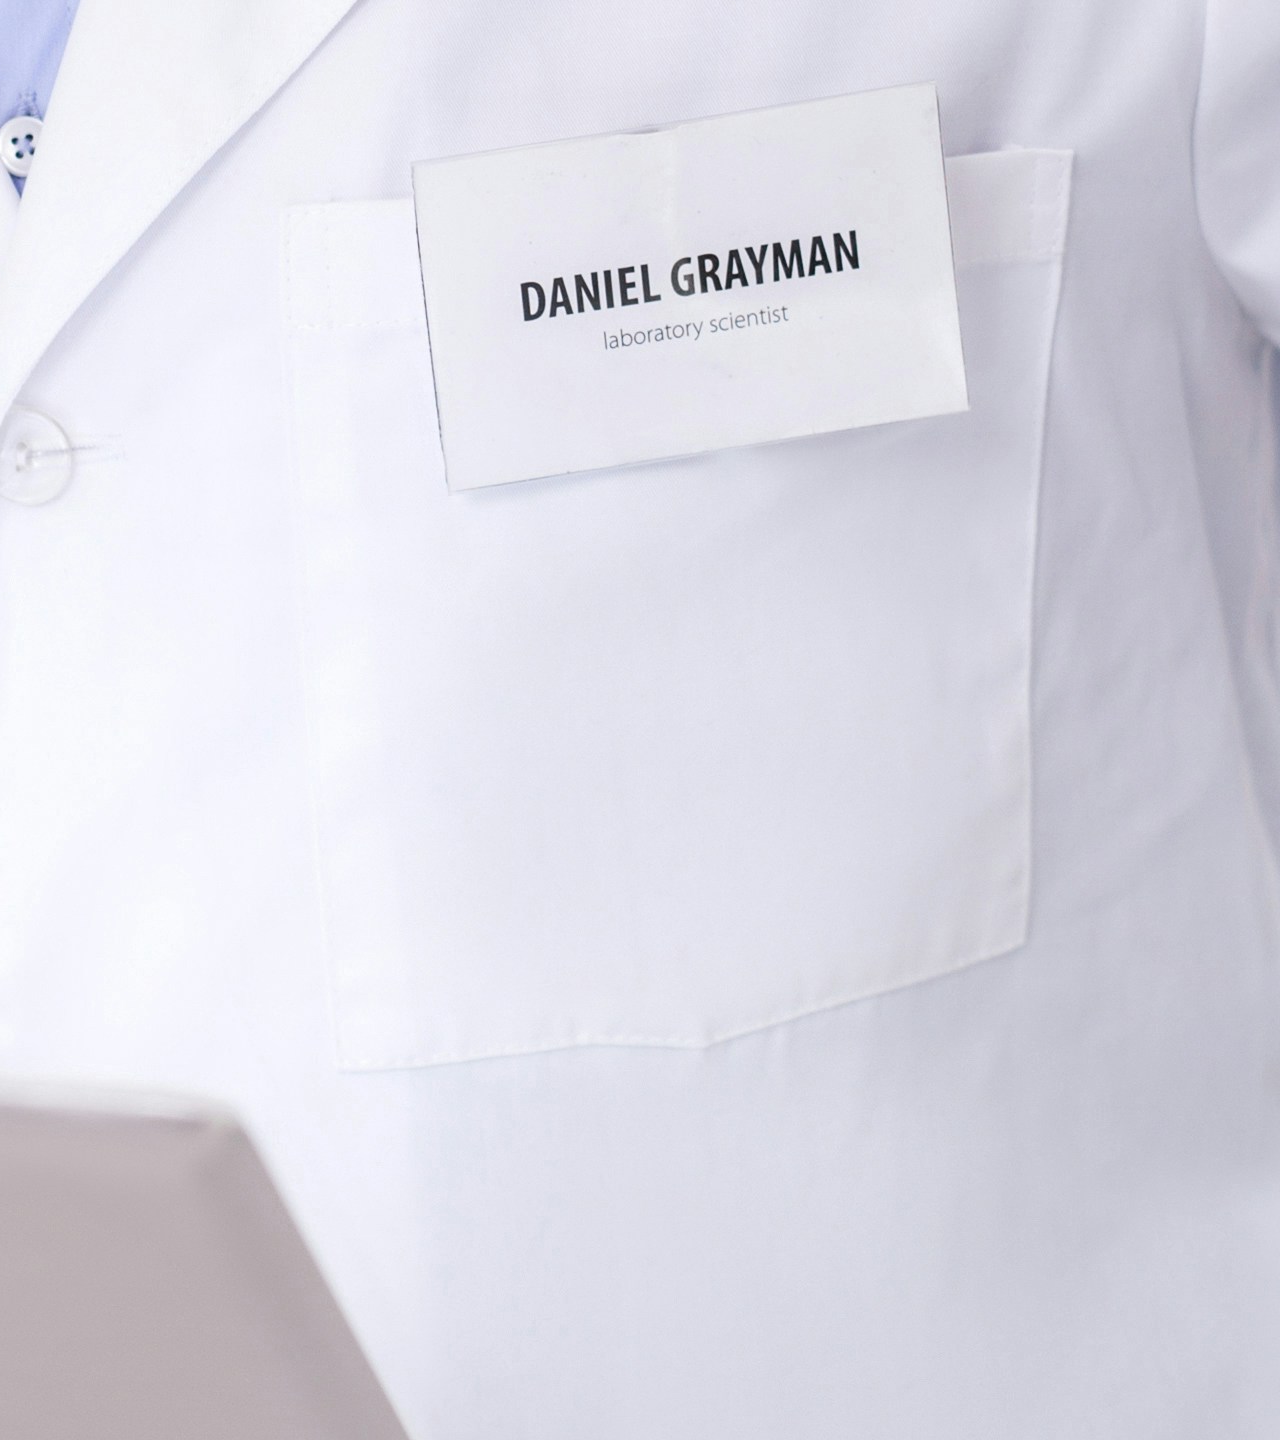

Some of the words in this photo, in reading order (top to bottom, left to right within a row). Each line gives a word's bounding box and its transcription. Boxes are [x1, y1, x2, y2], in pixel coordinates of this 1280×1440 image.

[519, 263, 662, 323] DANIEL
[670, 229, 861, 297] GRAYMAN
[603, 321, 704, 351] laboratory
[709, 305, 790, 334] scientist
